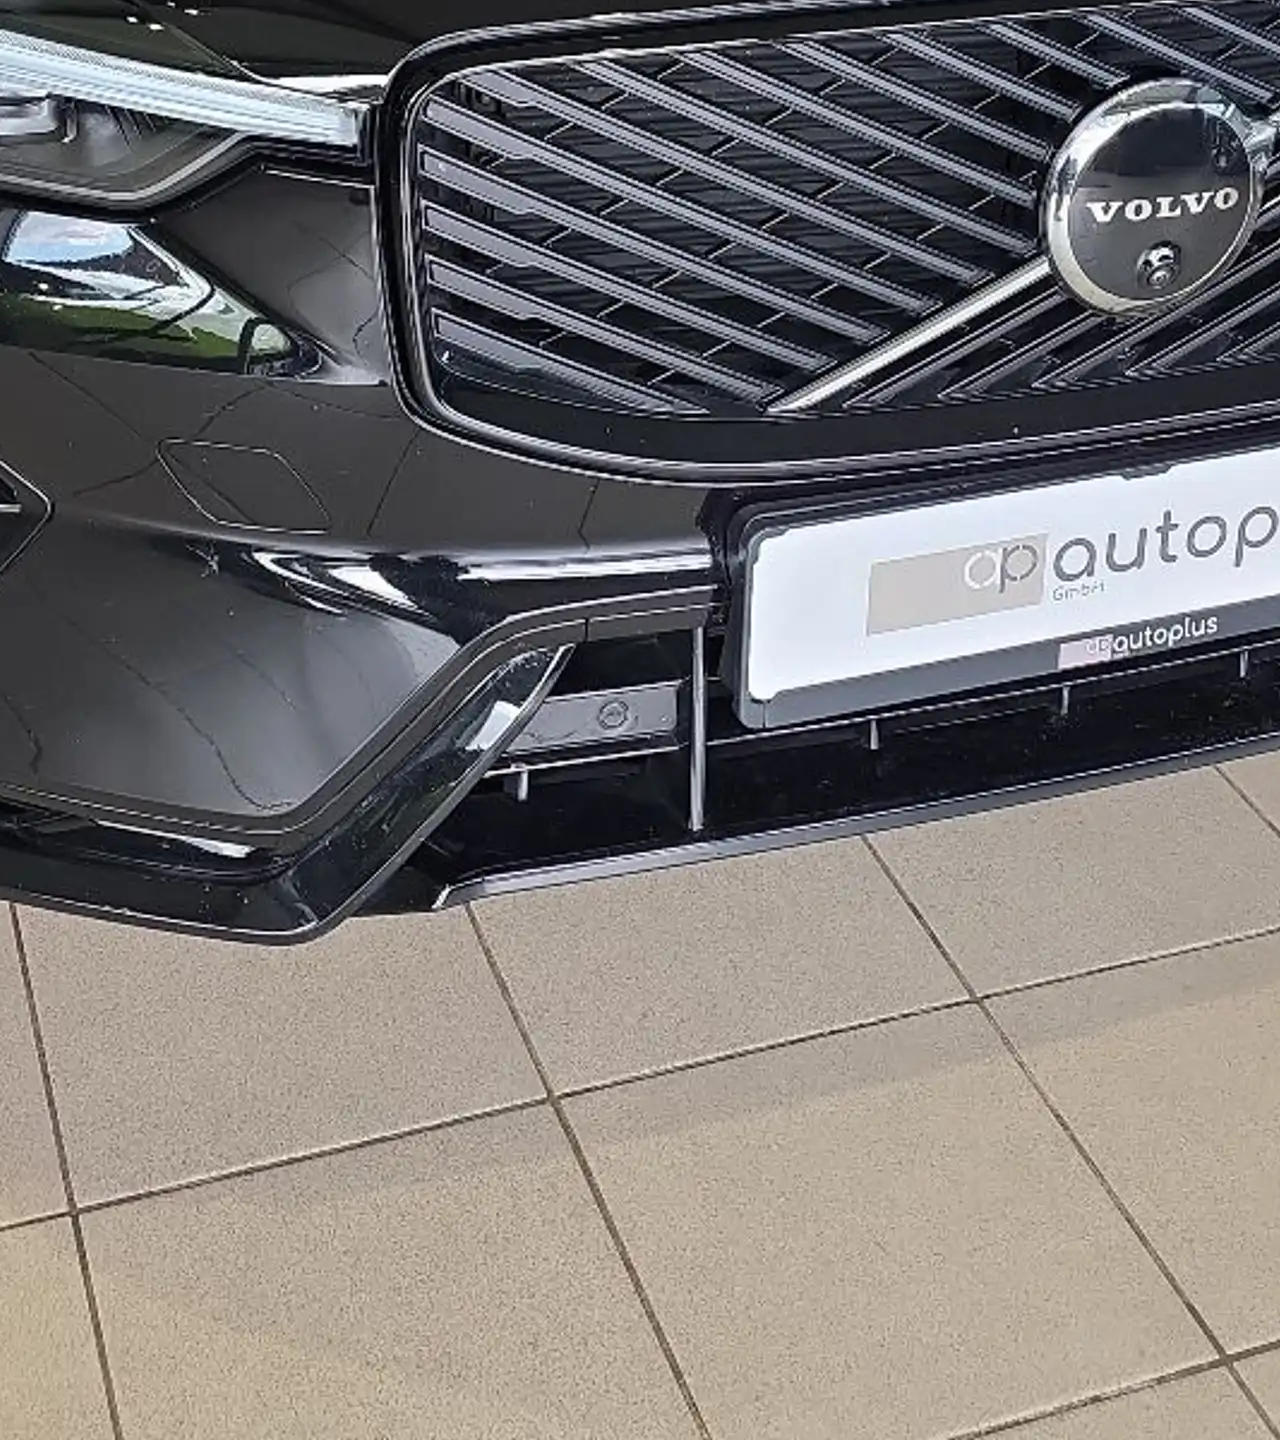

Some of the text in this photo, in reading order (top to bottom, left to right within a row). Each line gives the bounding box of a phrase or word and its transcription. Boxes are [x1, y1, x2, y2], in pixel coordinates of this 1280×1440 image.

[1086, 186, 1240, 223] VOLVO
[1052, 581, 1106, 602] GmbH
[1113, 616, 1219, 654] autoplus
